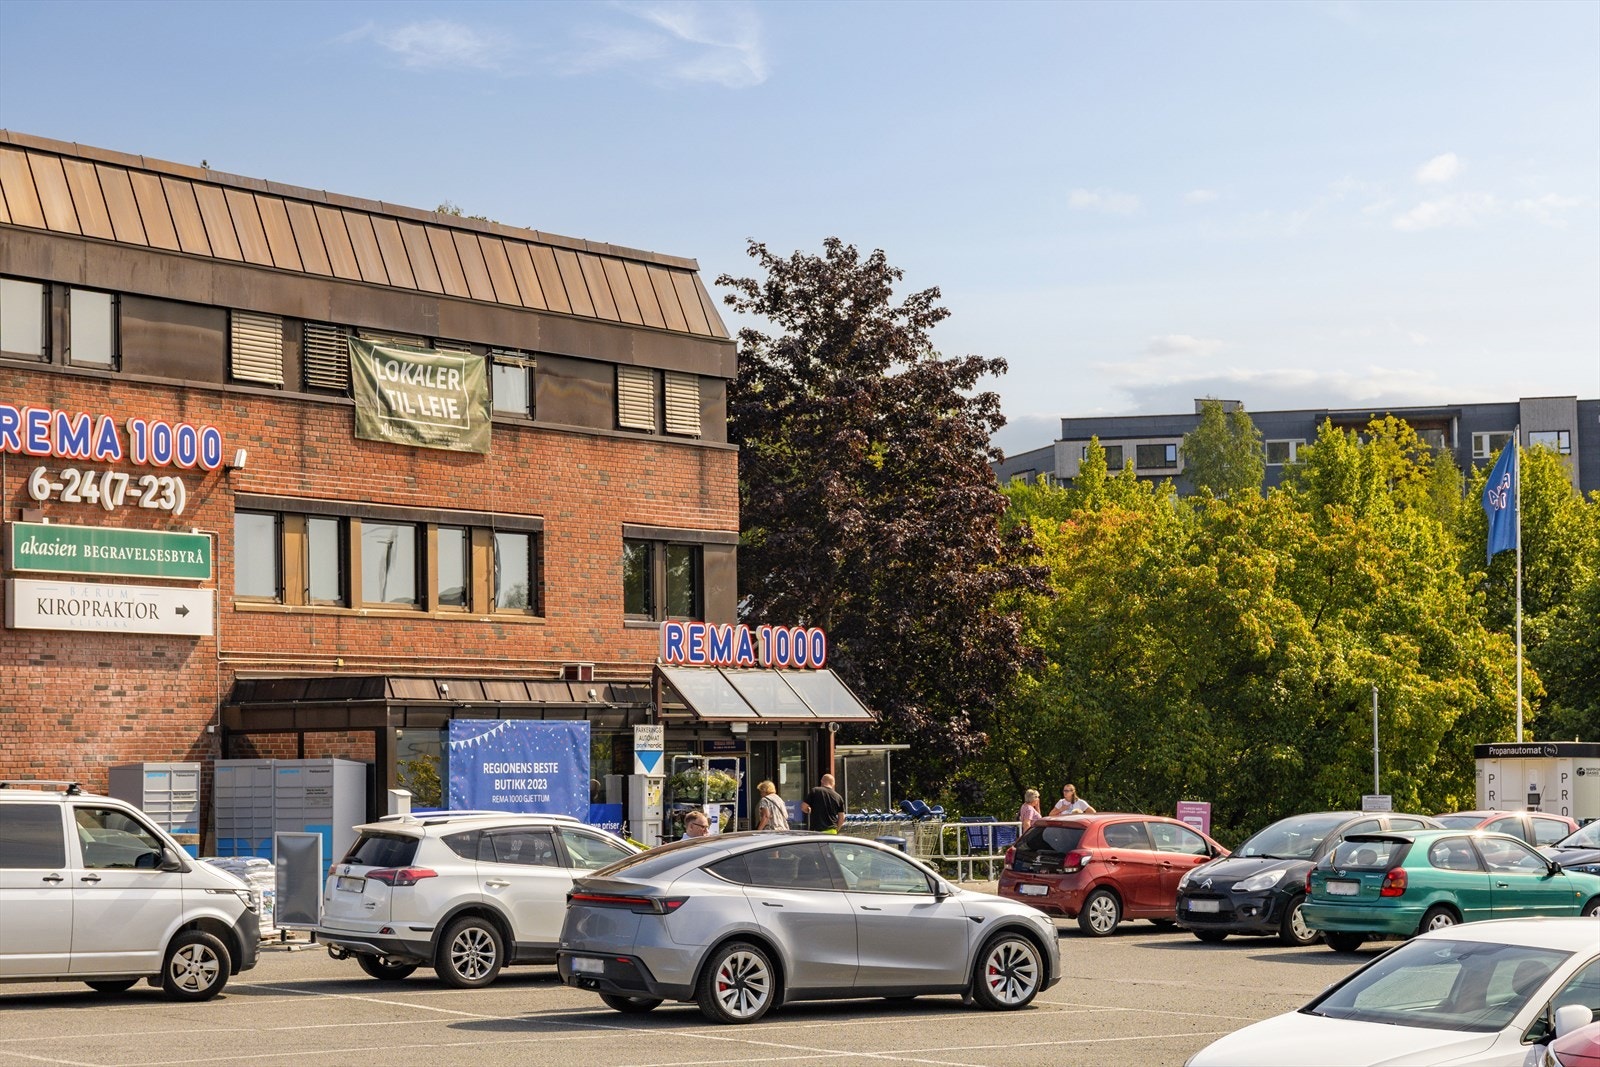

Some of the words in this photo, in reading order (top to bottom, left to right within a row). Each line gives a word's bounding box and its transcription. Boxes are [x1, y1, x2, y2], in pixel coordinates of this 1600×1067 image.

[374, 357, 461, 391] LOKALER
[385, 389, 416, 414] TIL
[417, 394, 461, 420] LEIE
[0, 405, 122, 463] REMA
[127, 417, 223, 472] 1000
[28, 466, 186, 516] 6-24(7-23)
[20, 536, 77, 557] akasien
[84, 545, 204, 564] BEGRAVELSESBYRÅ
[70, 586, 129, 599] BÆRUM
[37, 598, 159, 620] KIROPRAKTOR
[659, 620, 755, 667] REMA
[756, 624, 827, 669] 1000
[1488, 746, 1542, 757] Propanautomat
[483, 762, 533, 774] REGIONENS
[533, 762, 559, 774] BESTE
[494, 779, 527, 790] BUTIKK
[527, 778, 548, 790] 2023
[492, 795, 509, 803] REMA
[508, 795, 523, 803] 1000
[523, 795, 550, 803] GJETTUM
[601, 820, 620, 830] priser
